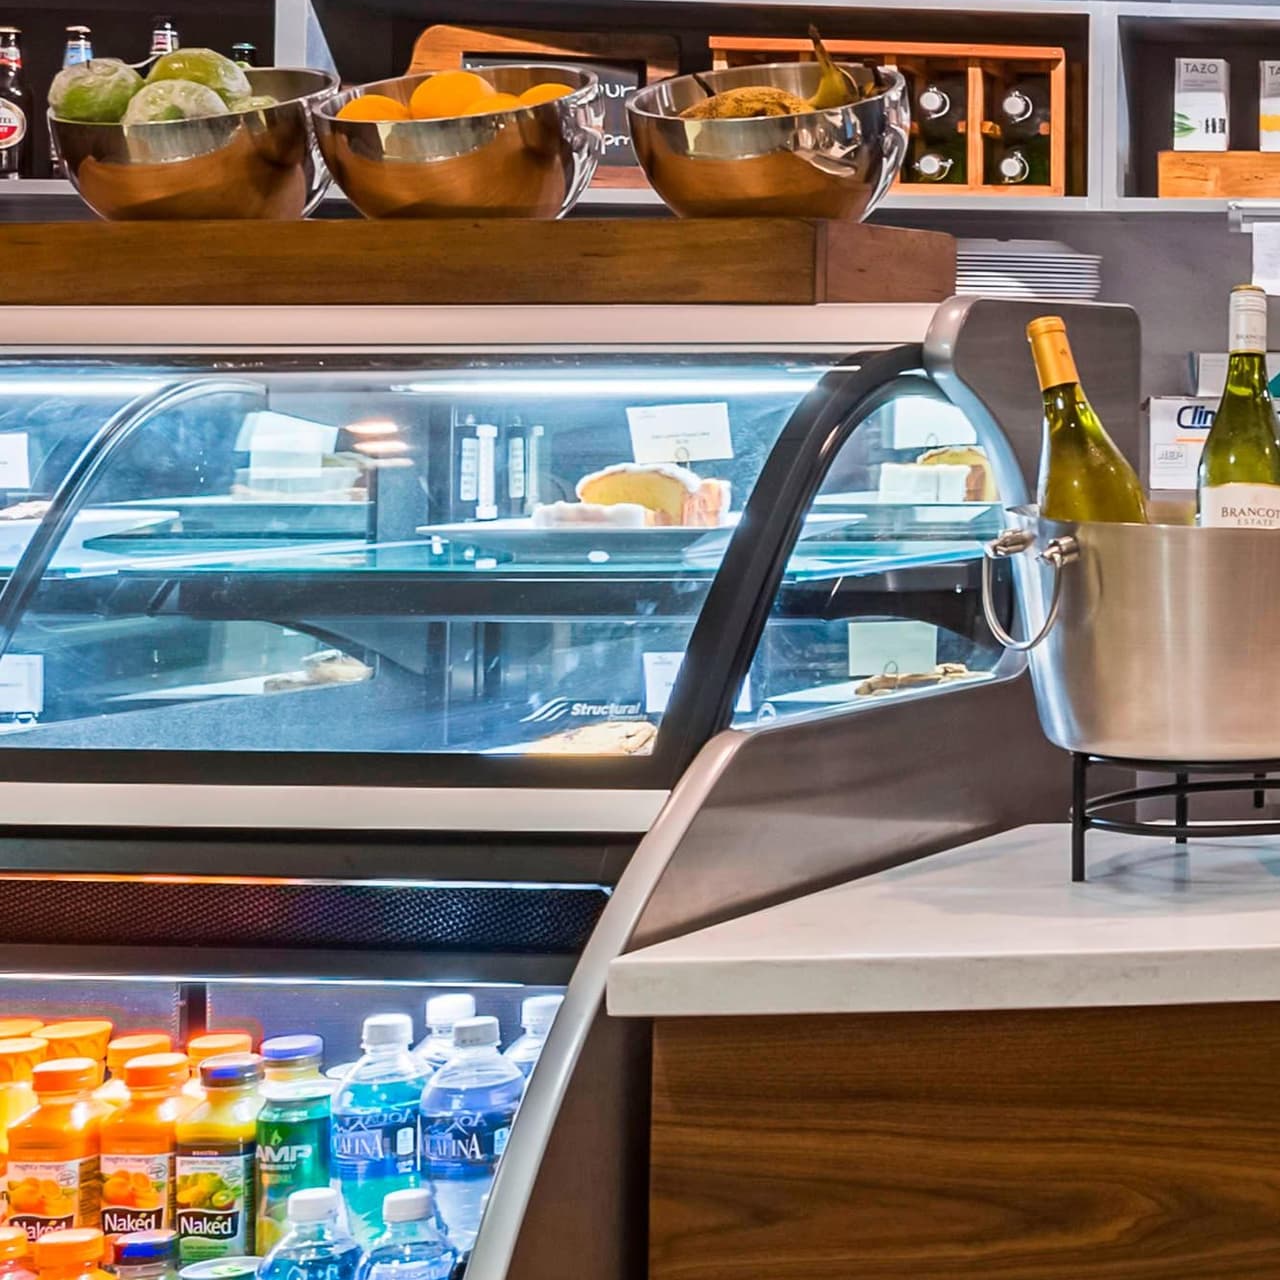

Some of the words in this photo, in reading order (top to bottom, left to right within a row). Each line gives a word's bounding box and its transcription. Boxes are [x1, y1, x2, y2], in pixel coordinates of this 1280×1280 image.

[1184, 62, 1218, 74] TAZO
[571, 703, 641, 717] Structural
[256, 1144, 313, 1163] AMP
[105, 1211, 156, 1231] Naked
[180, 1214, 232, 1234] Naked
